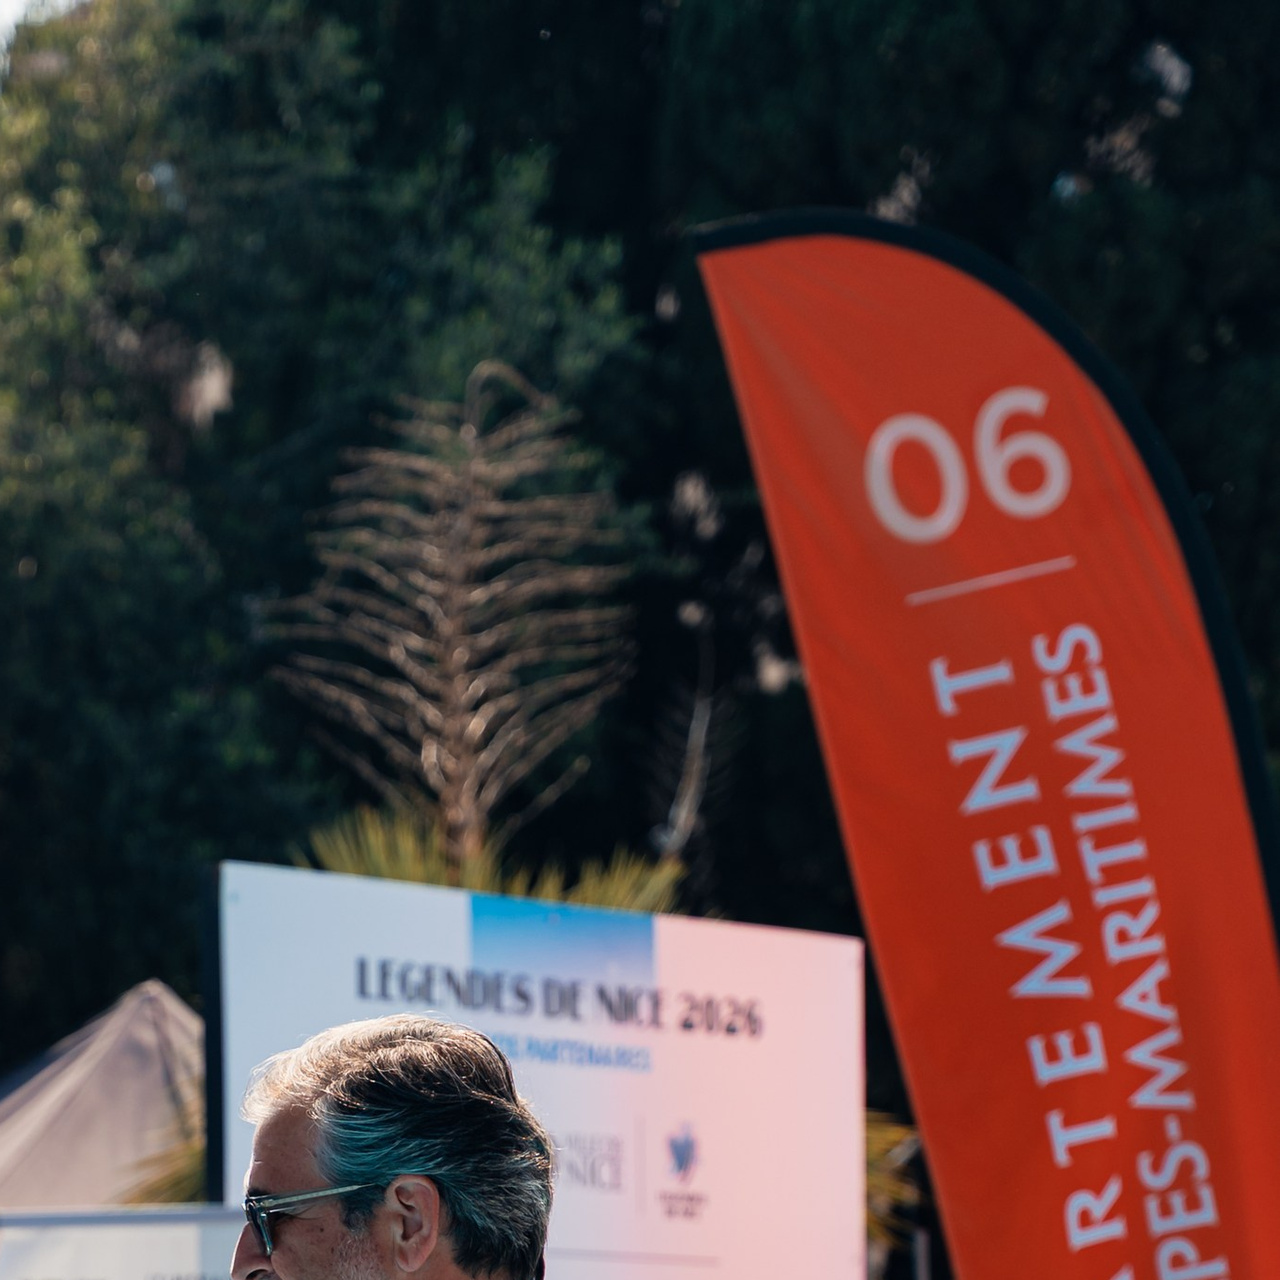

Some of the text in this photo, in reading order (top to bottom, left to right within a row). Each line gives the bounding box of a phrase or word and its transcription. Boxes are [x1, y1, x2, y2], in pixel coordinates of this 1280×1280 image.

[864, 385, 1072, 546] 06
[354, 957, 764, 1037] LEGENDES DE NICE 2026
